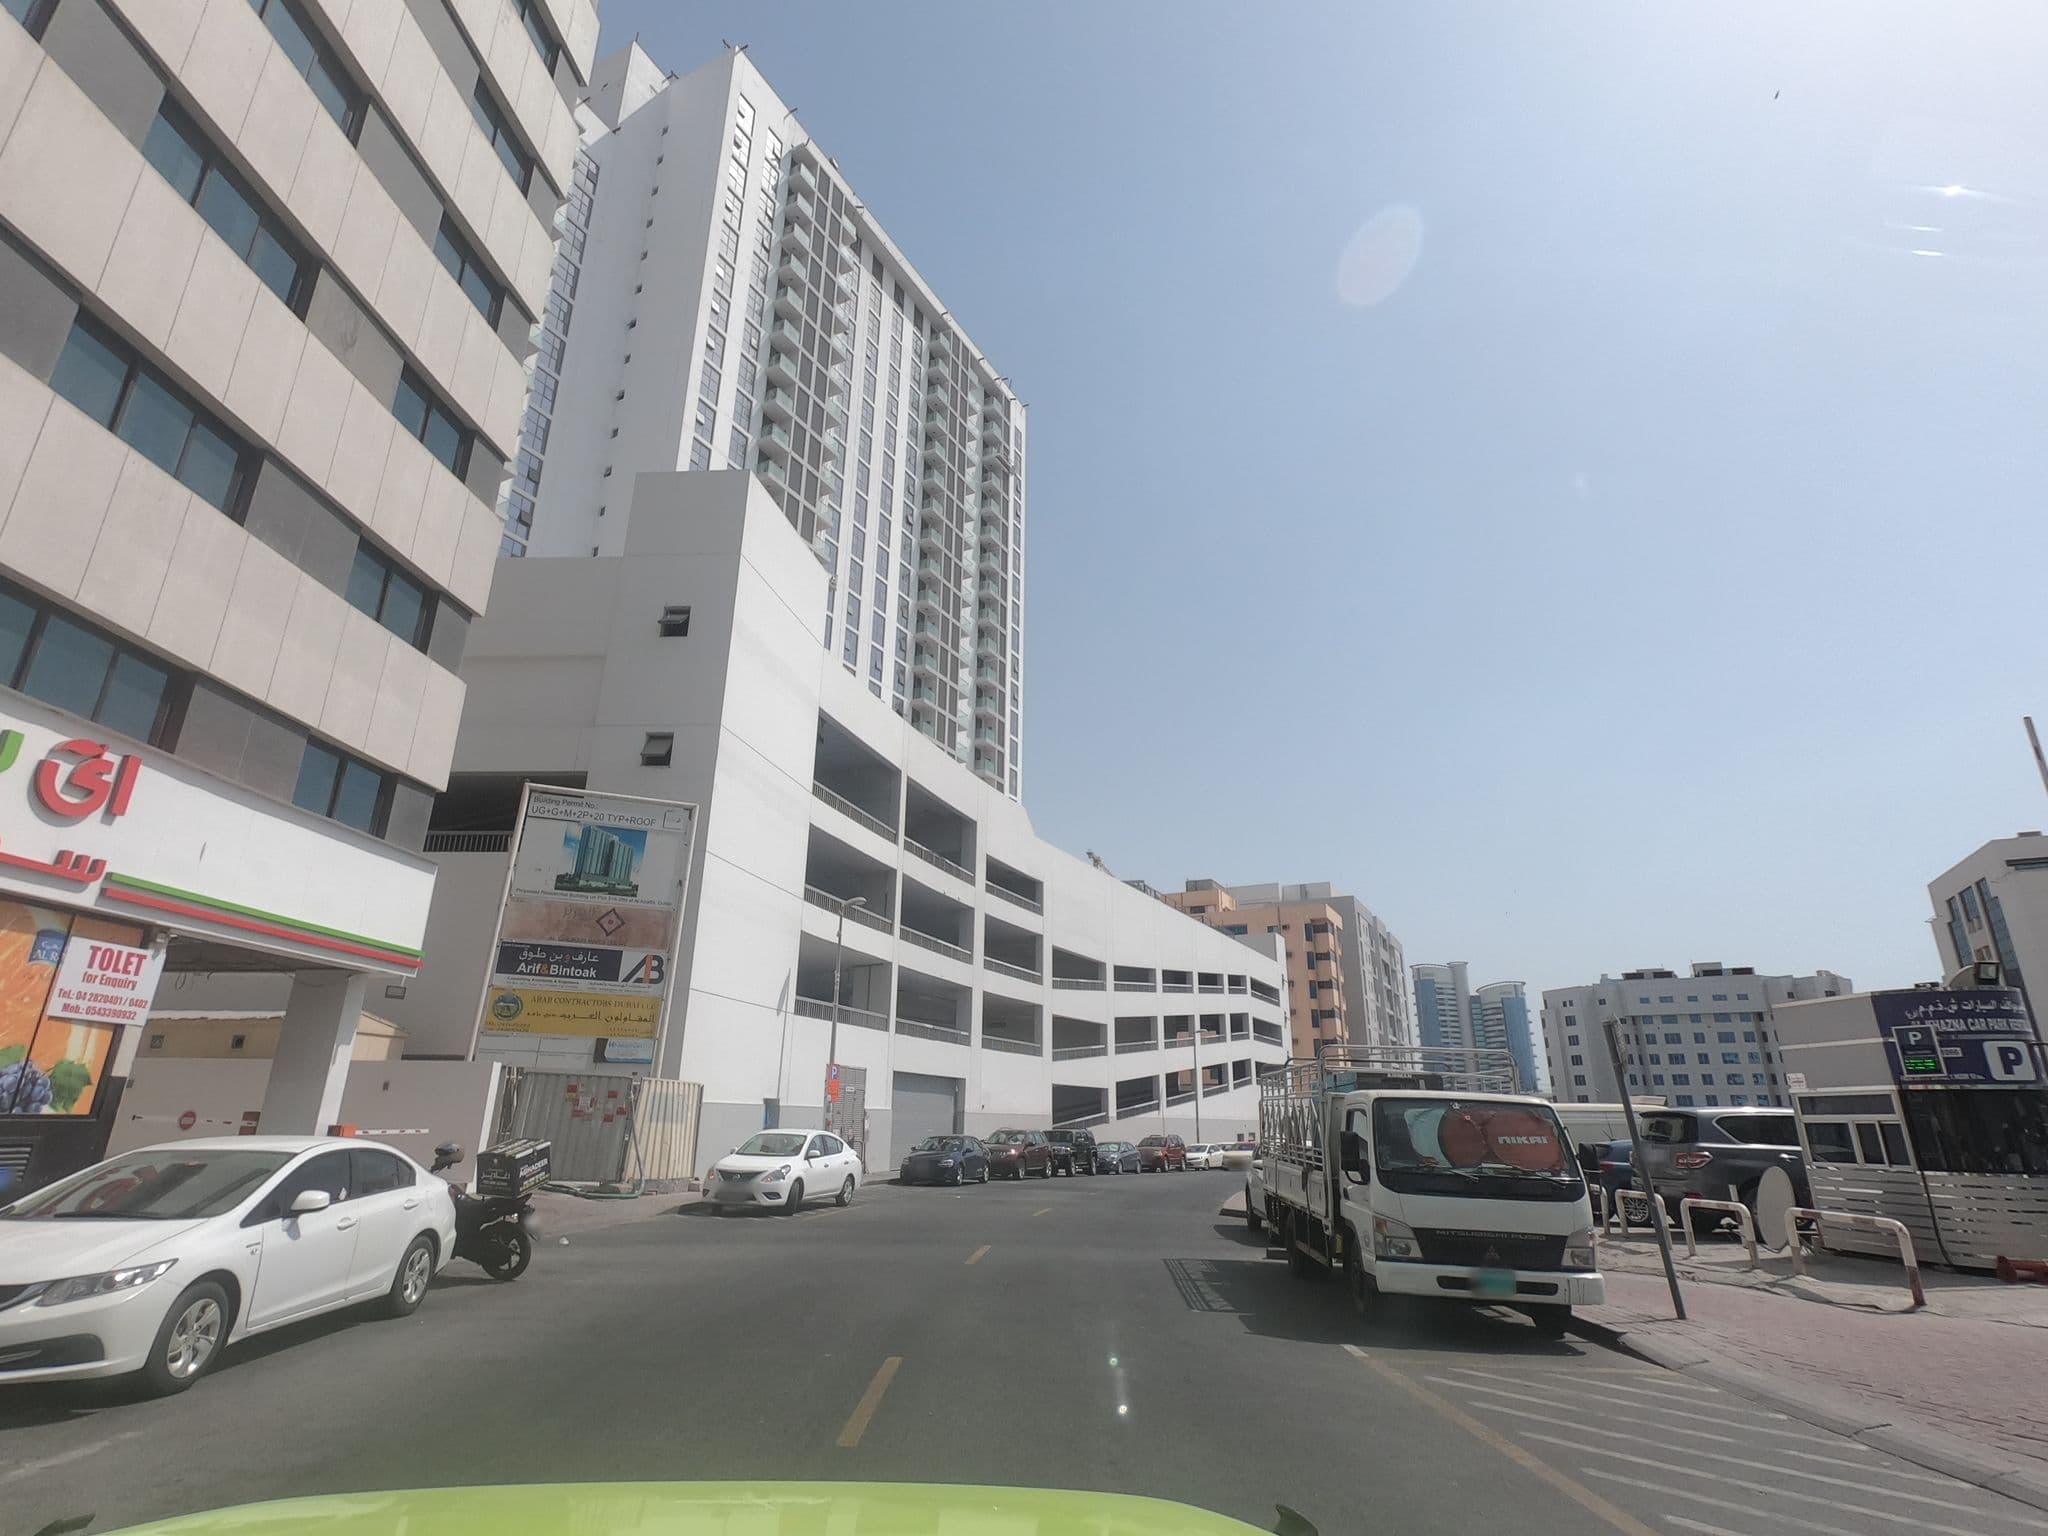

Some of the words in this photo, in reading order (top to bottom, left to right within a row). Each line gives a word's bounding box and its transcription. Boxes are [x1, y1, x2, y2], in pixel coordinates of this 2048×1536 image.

[533, 796, 560, 806] Building
[531, 806, 605, 820] UG+G+M+2P+20
[607, 813, 657, 826] TYP+ROOF
[86, 945, 147, 976] TOLET
[81, 971, 97, 983] for
[99, 974, 138, 991] Enquiry
[76, 991, 87, 1001] 04
[128, 998, 149, 1009] 0402
[1967, 1018, 1988, 1031] CAR
[1987, 1018, 2010, 1031] PARK
[1908, 1031, 1922, 1046] P
[1997, 1046, 2023, 1075] P
[831, 1066, 838, 1080] P
[1498, 1135, 1549, 1145] NIKAI
[1436, 1230, 1508, 1239] MITSUBISHI
[1510, 1233, 1547, 1241] FUSO
